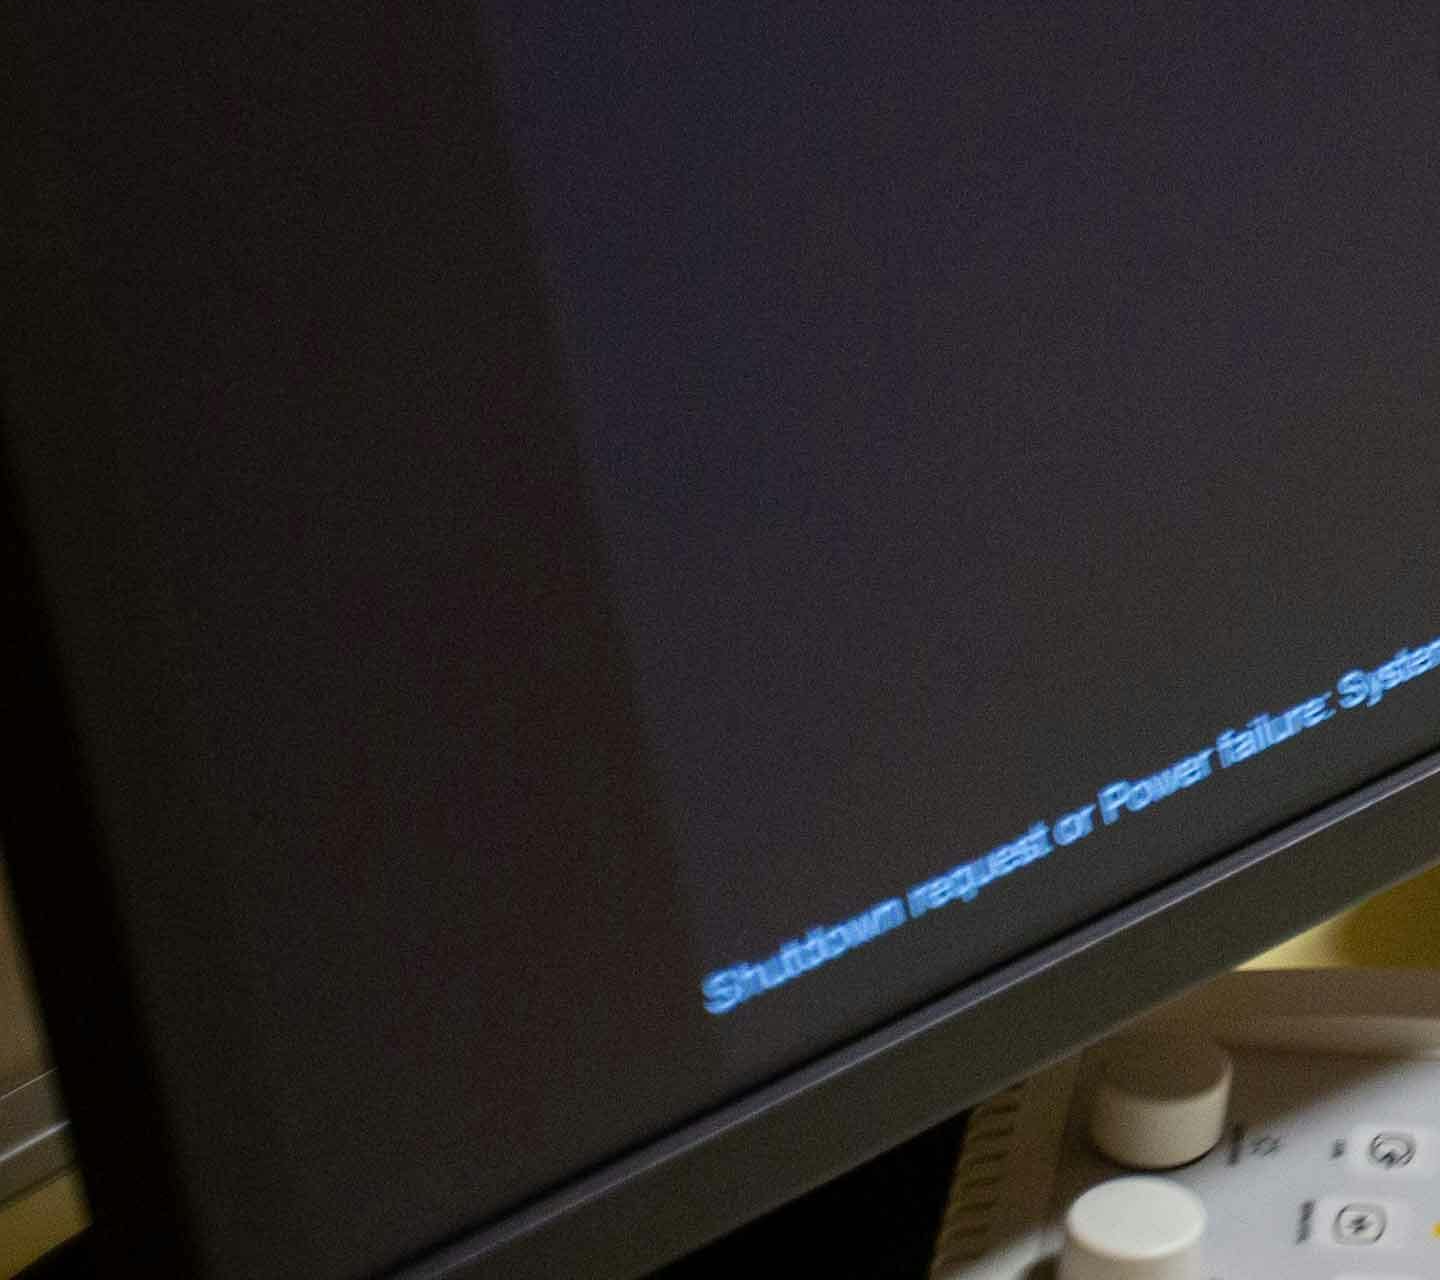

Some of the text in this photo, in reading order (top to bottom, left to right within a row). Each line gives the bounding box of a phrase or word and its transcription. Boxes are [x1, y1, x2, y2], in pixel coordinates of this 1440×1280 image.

[702, 897, 908, 1016] Shutdown
[906, 819, 1055, 919] request
[1052, 803, 1097, 848] or
[1096, 747, 1218, 826] Power
